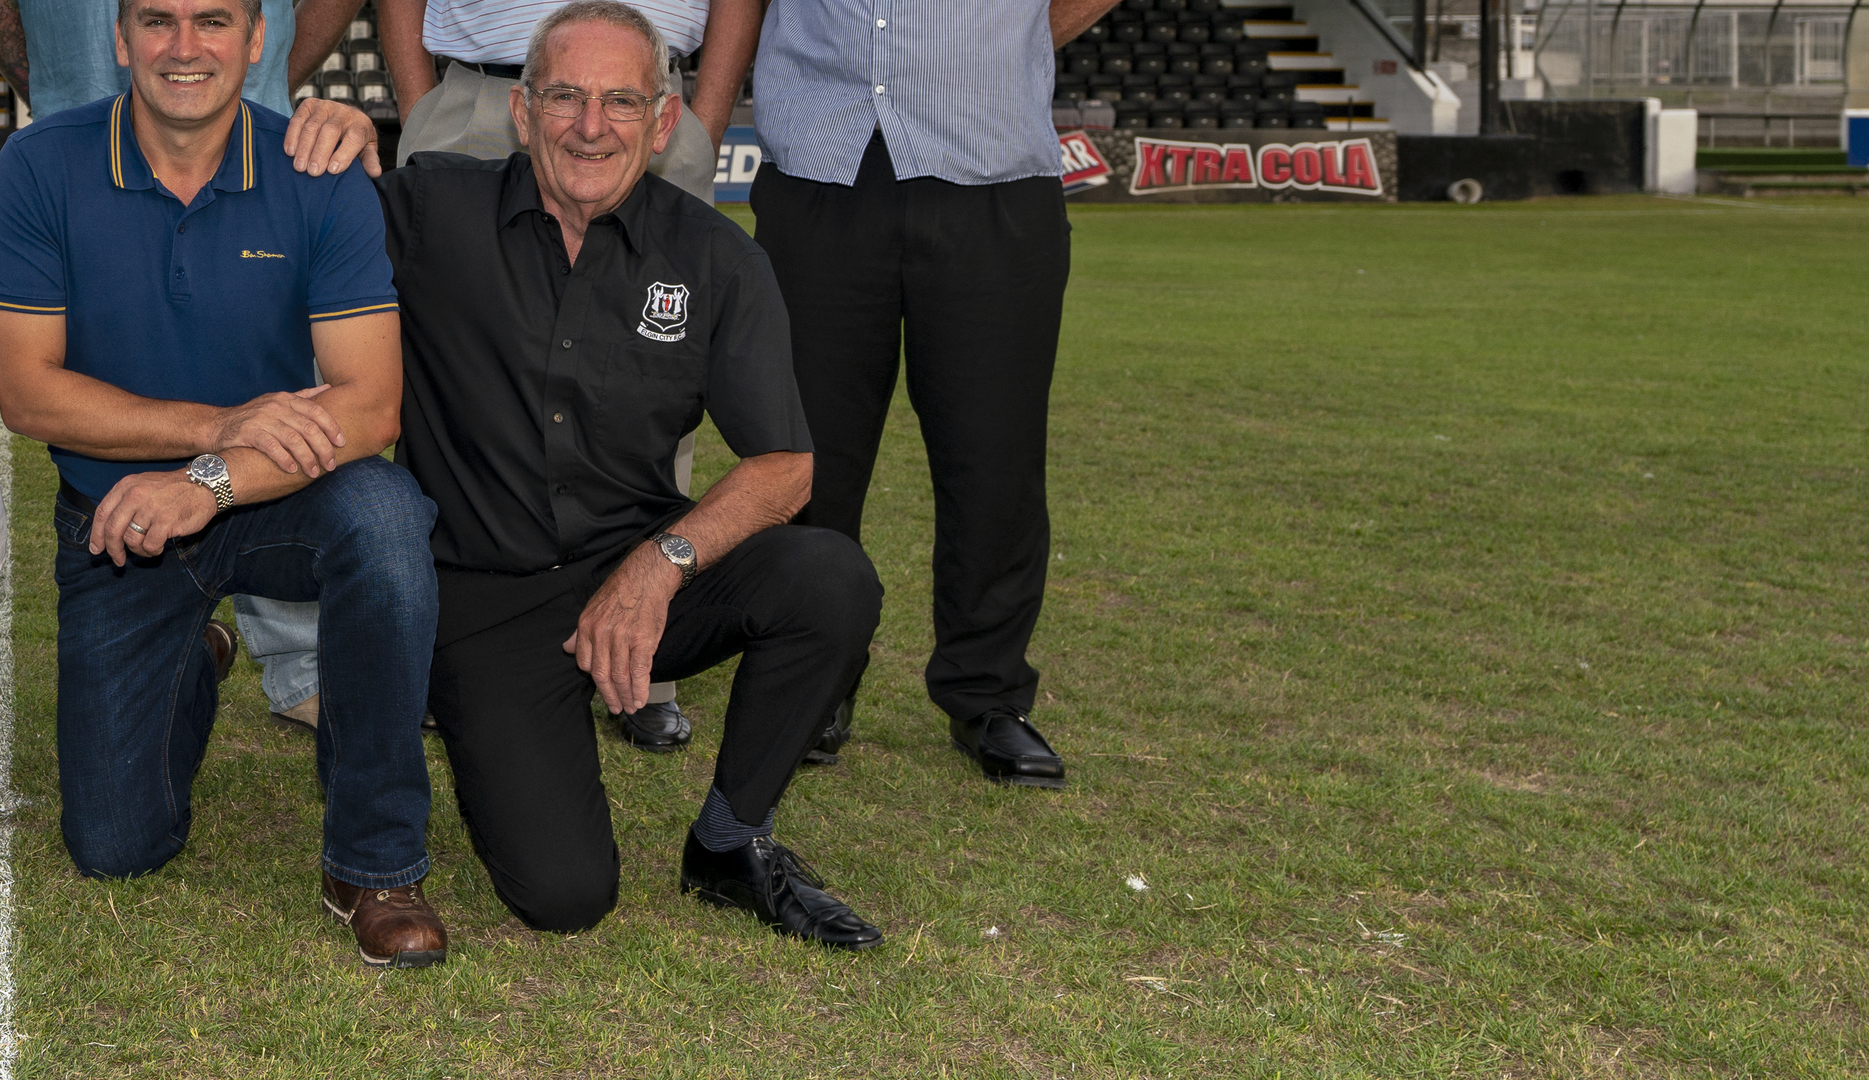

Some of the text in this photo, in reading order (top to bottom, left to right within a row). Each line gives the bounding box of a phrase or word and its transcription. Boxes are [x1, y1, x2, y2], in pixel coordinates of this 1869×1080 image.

[1060, 138, 1100, 174] RR
[1134, 140, 1377, 190] XTRA COLA
[641, 329, 658, 339] ELGIN
